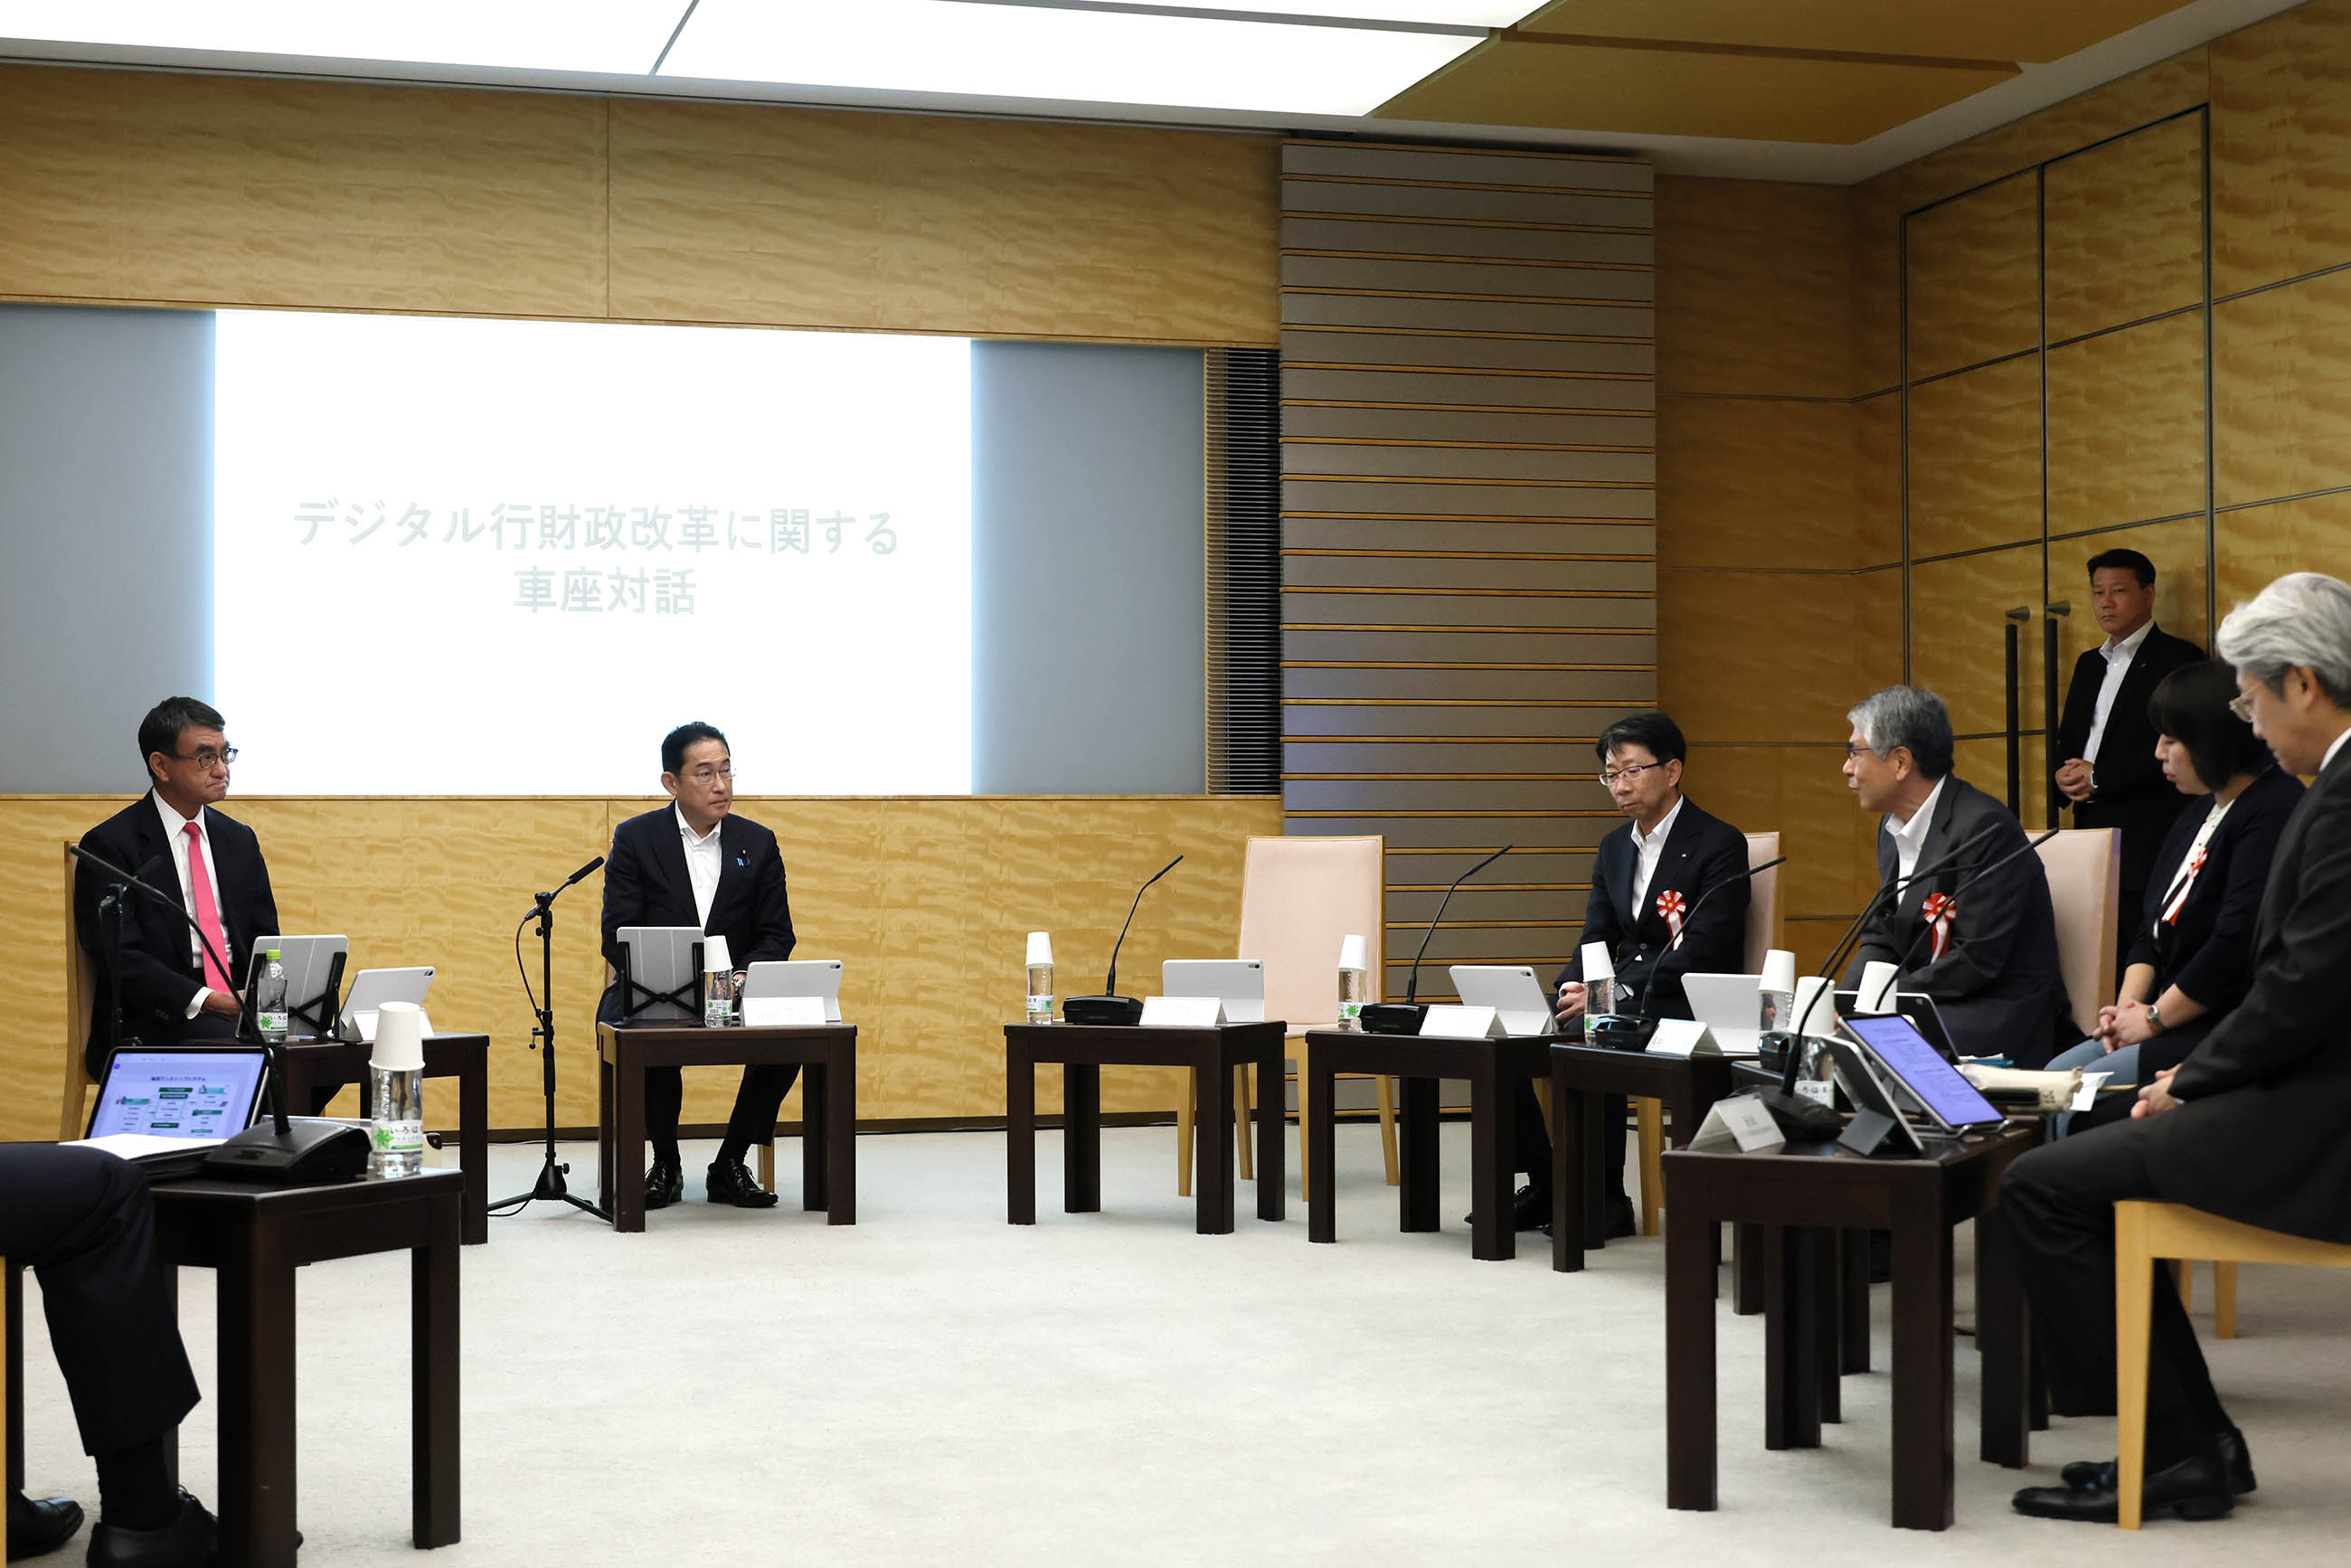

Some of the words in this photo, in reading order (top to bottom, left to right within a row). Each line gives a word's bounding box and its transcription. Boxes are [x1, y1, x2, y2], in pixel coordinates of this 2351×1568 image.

[293, 496, 898, 555] デジタル行財政改革に関する
[513, 564, 697, 615] 車座対話
